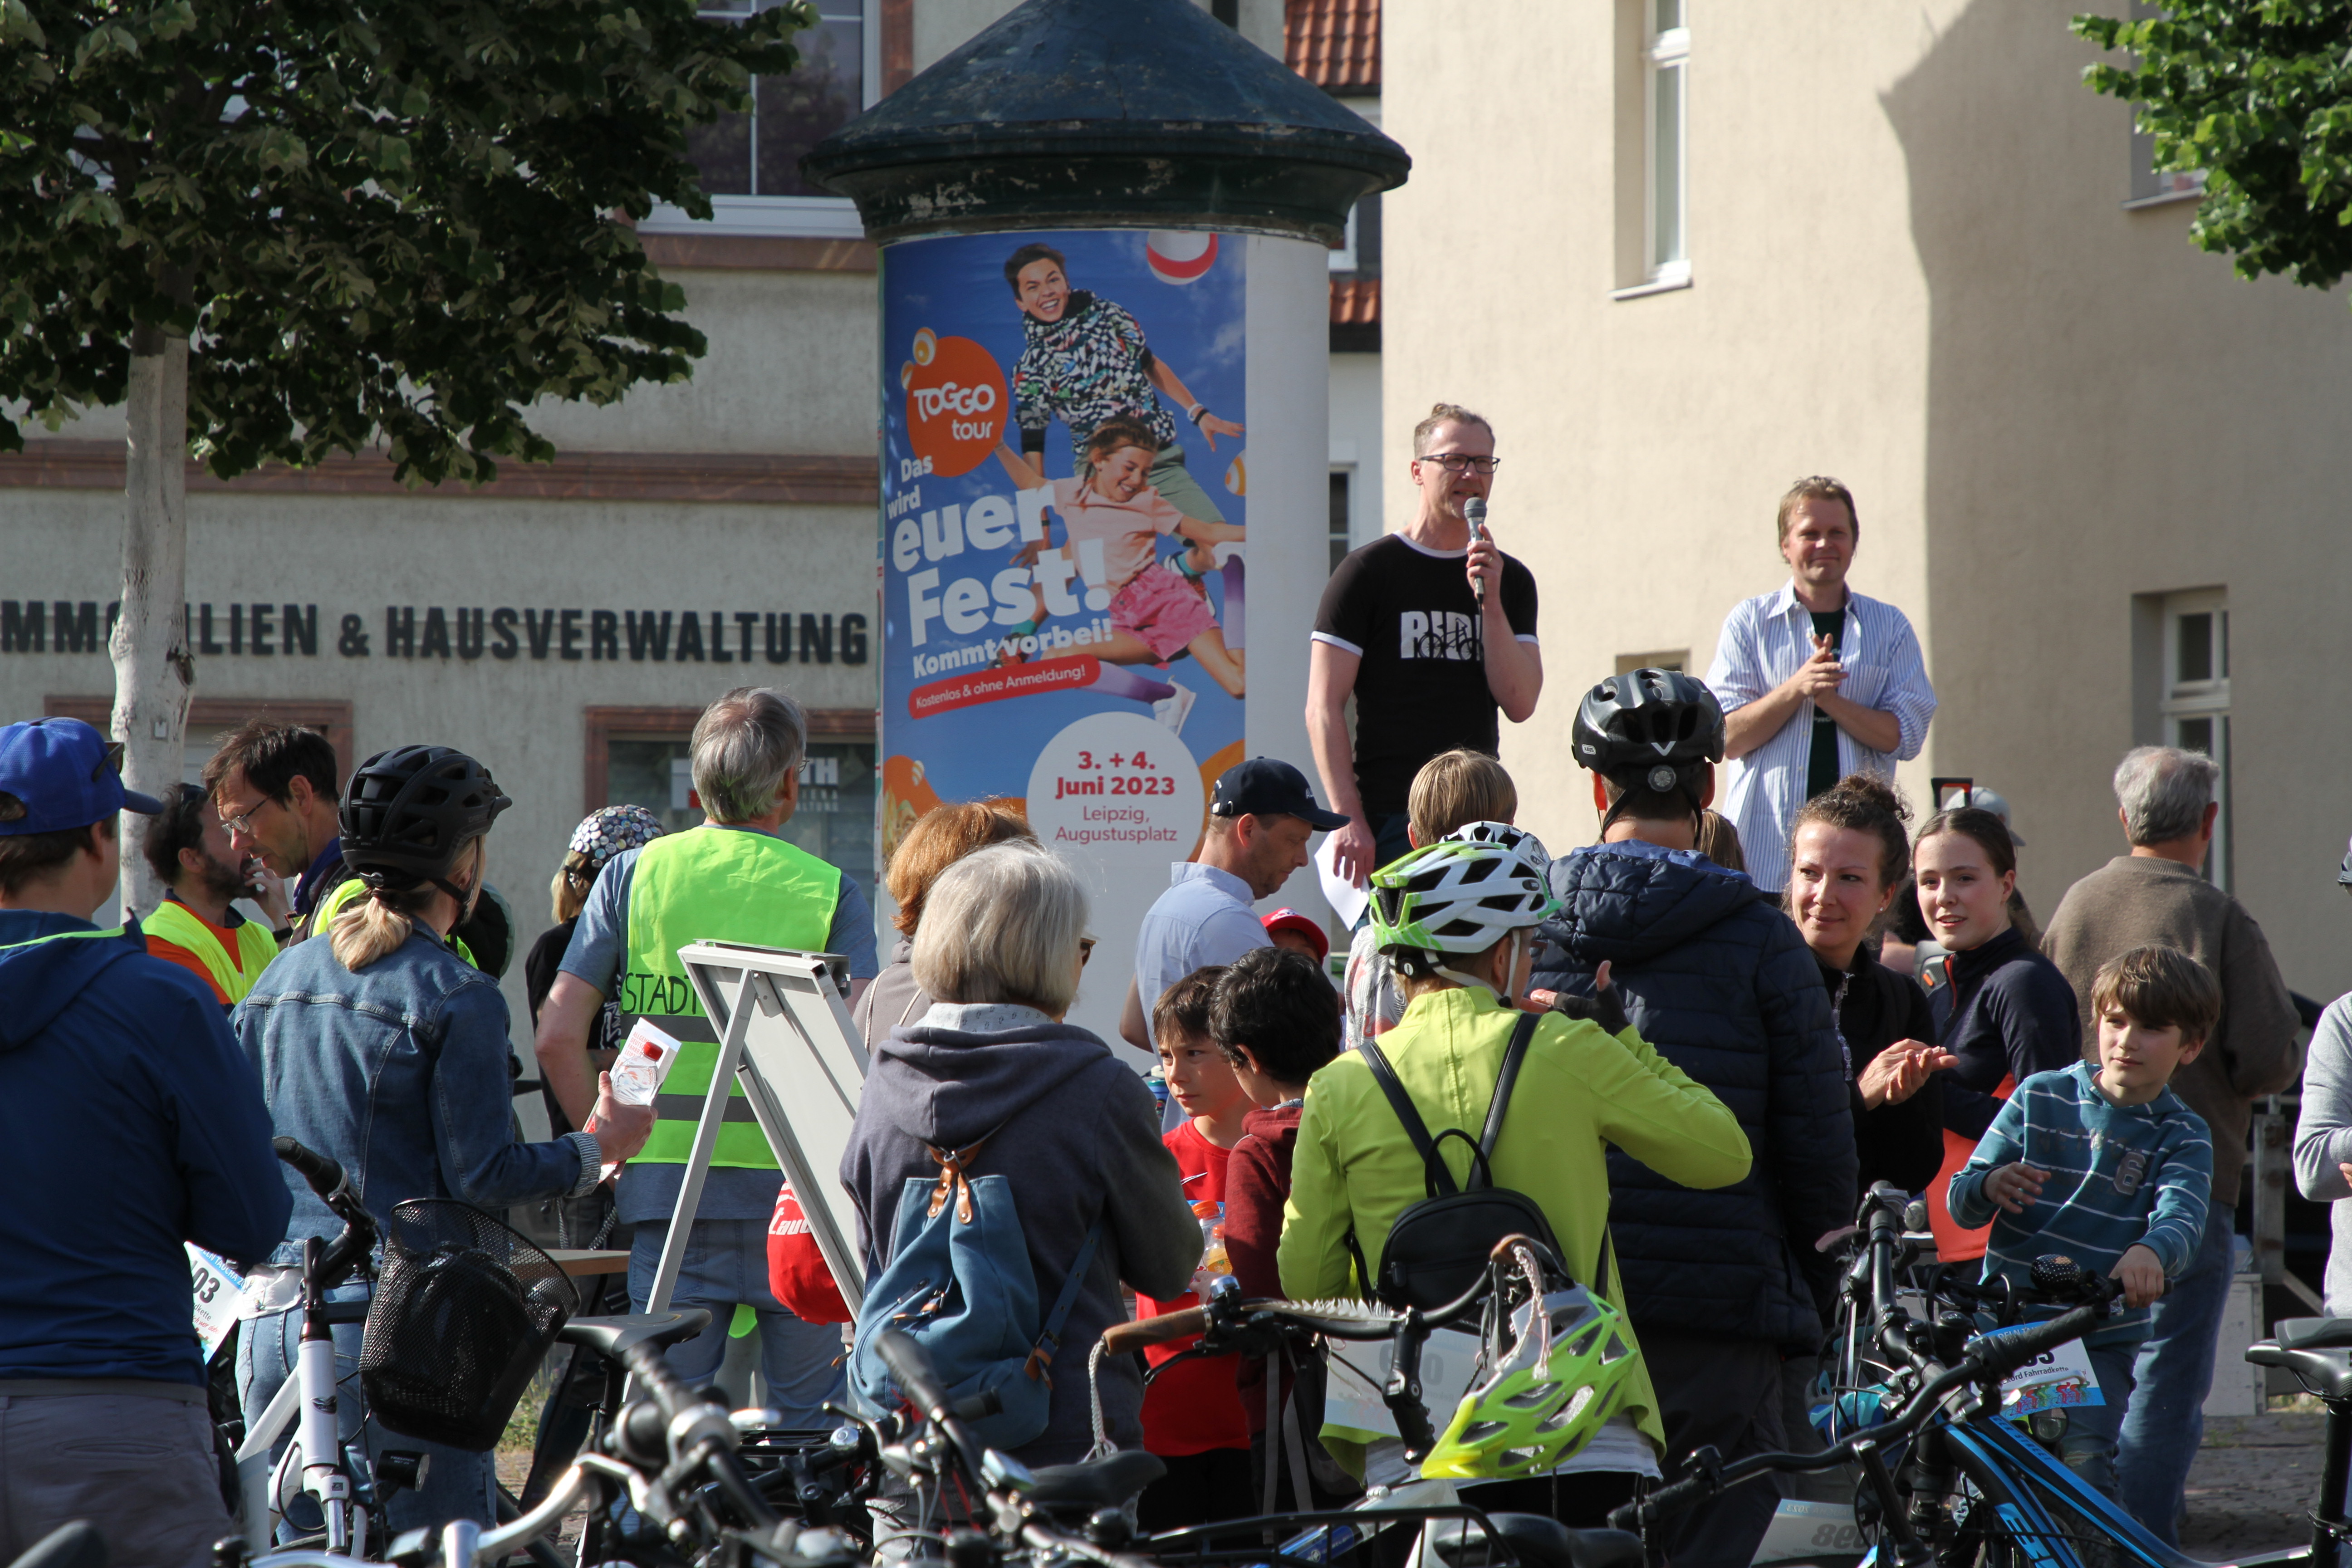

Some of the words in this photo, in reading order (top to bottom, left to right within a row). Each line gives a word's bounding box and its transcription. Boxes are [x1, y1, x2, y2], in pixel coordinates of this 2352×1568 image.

[913, 382, 995, 422] TOGGO
[952, 419, 993, 440] tour
[901, 455, 934, 483] Das
[887, 484, 921, 519] wird
[892, 484, 1056, 572] euer
[907, 538, 1112, 647] Fest!
[339, 614, 369, 657] &
[386, 606, 868, 665] HAUSVERWALTUNG
[912, 638, 998, 679] Kommt
[1001, 618, 1113, 657] vorbei!
[916, 689, 961, 709] Kostenlos
[962, 684, 971, 697] &
[973, 680, 1004, 696] ohne
[1005, 664, 1086, 689] Anmeldung!
[1078, 750, 1102, 770] 3.
[1109, 752, 1125, 768] +
[1132, 750, 1156, 770] 4.
[1055, 775, 1104, 799] Juni
[1111, 776, 1175, 795] 2023
[1083, 805, 1150, 824] Leipzig,
[1055, 826, 1178, 844] Augustusplatz
[2113, 1152, 2146, 1196] 6
